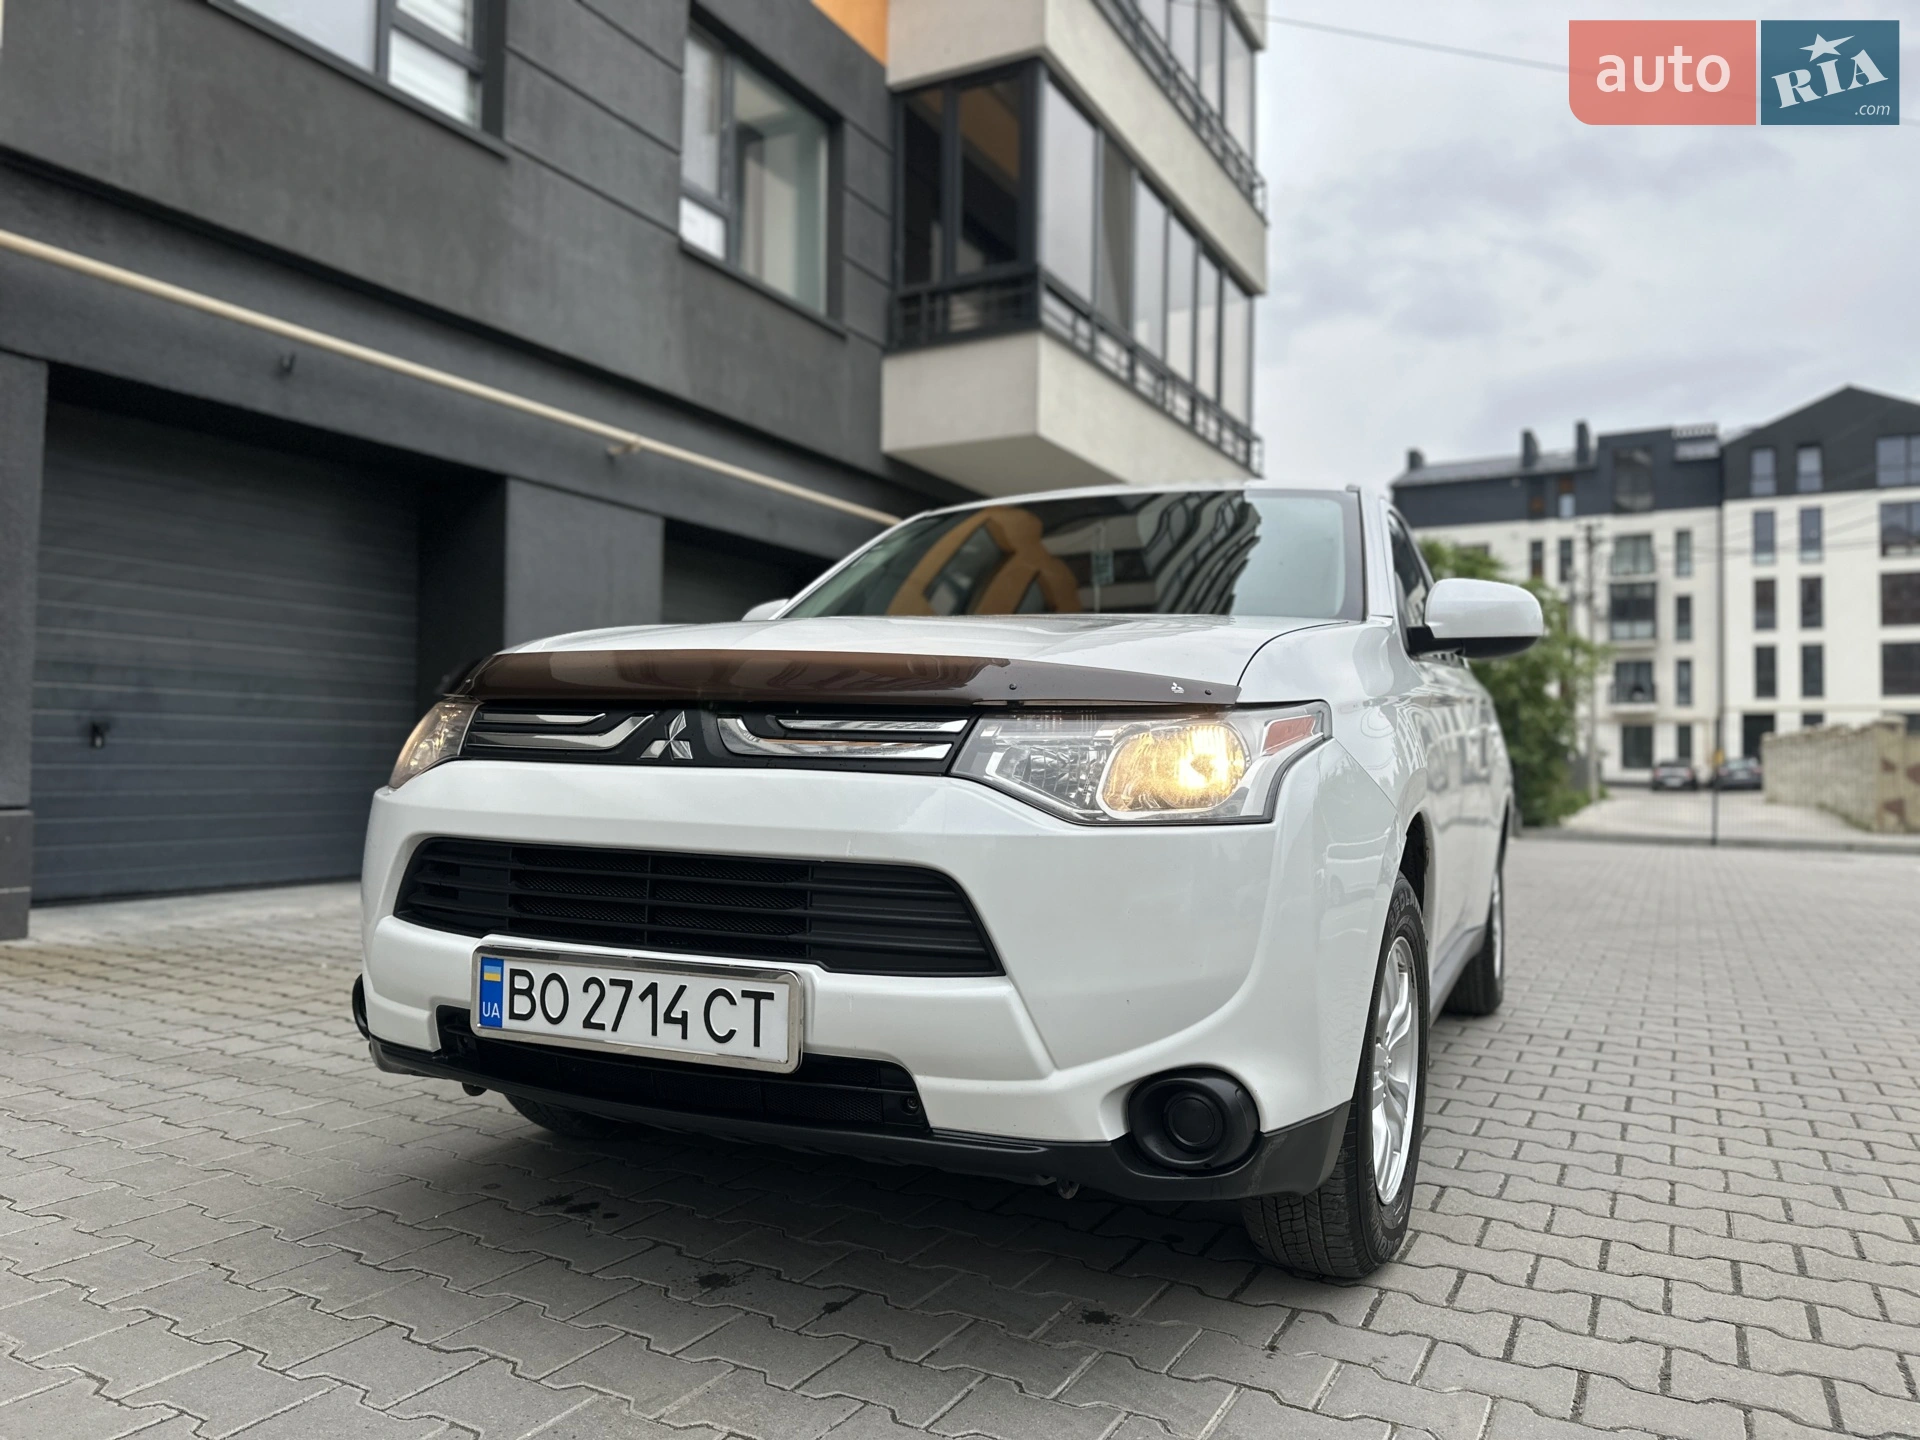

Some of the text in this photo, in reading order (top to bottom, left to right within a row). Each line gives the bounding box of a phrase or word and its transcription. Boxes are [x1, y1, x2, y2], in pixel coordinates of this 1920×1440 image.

[482, 1001, 500, 1019] UA
[508, 968, 775, 1048] BO 2714 CT
